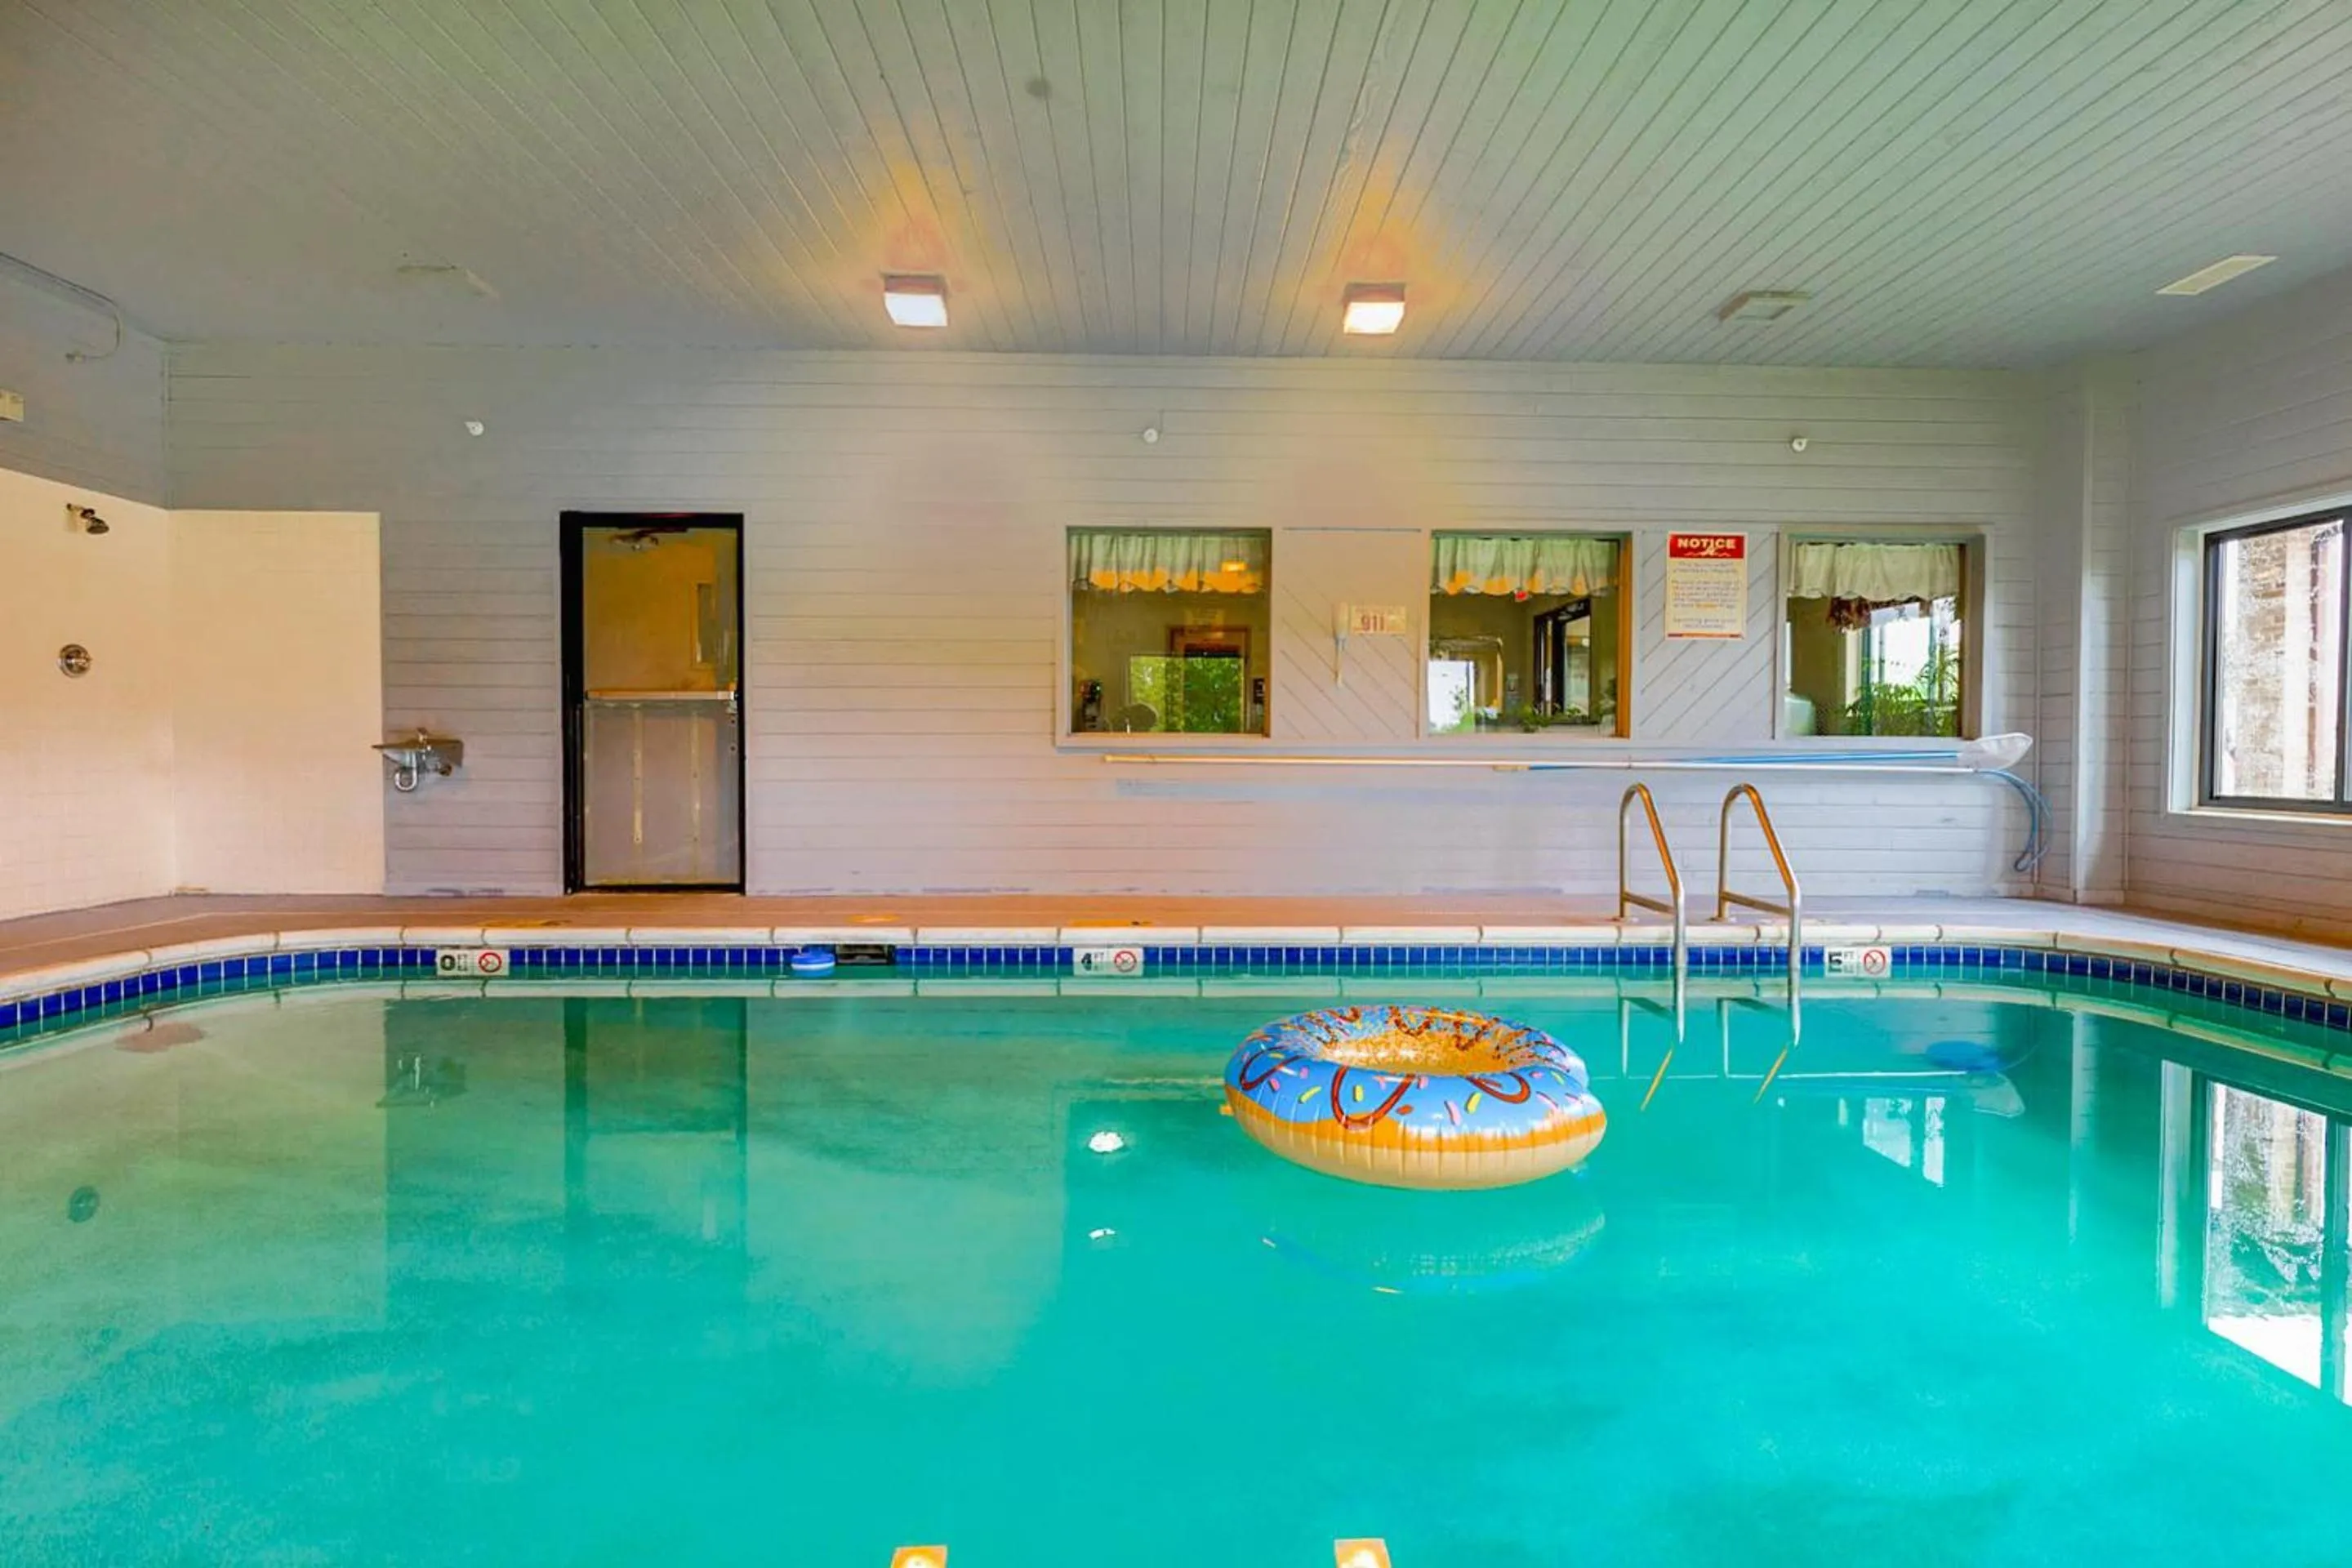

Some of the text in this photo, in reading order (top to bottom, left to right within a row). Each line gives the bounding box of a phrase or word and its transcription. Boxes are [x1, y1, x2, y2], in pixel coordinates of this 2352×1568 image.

[1677, 537, 1736, 549] NOTICE
[1361, 614, 1384, 632] 911
[1829, 951, 1842, 968] 5
